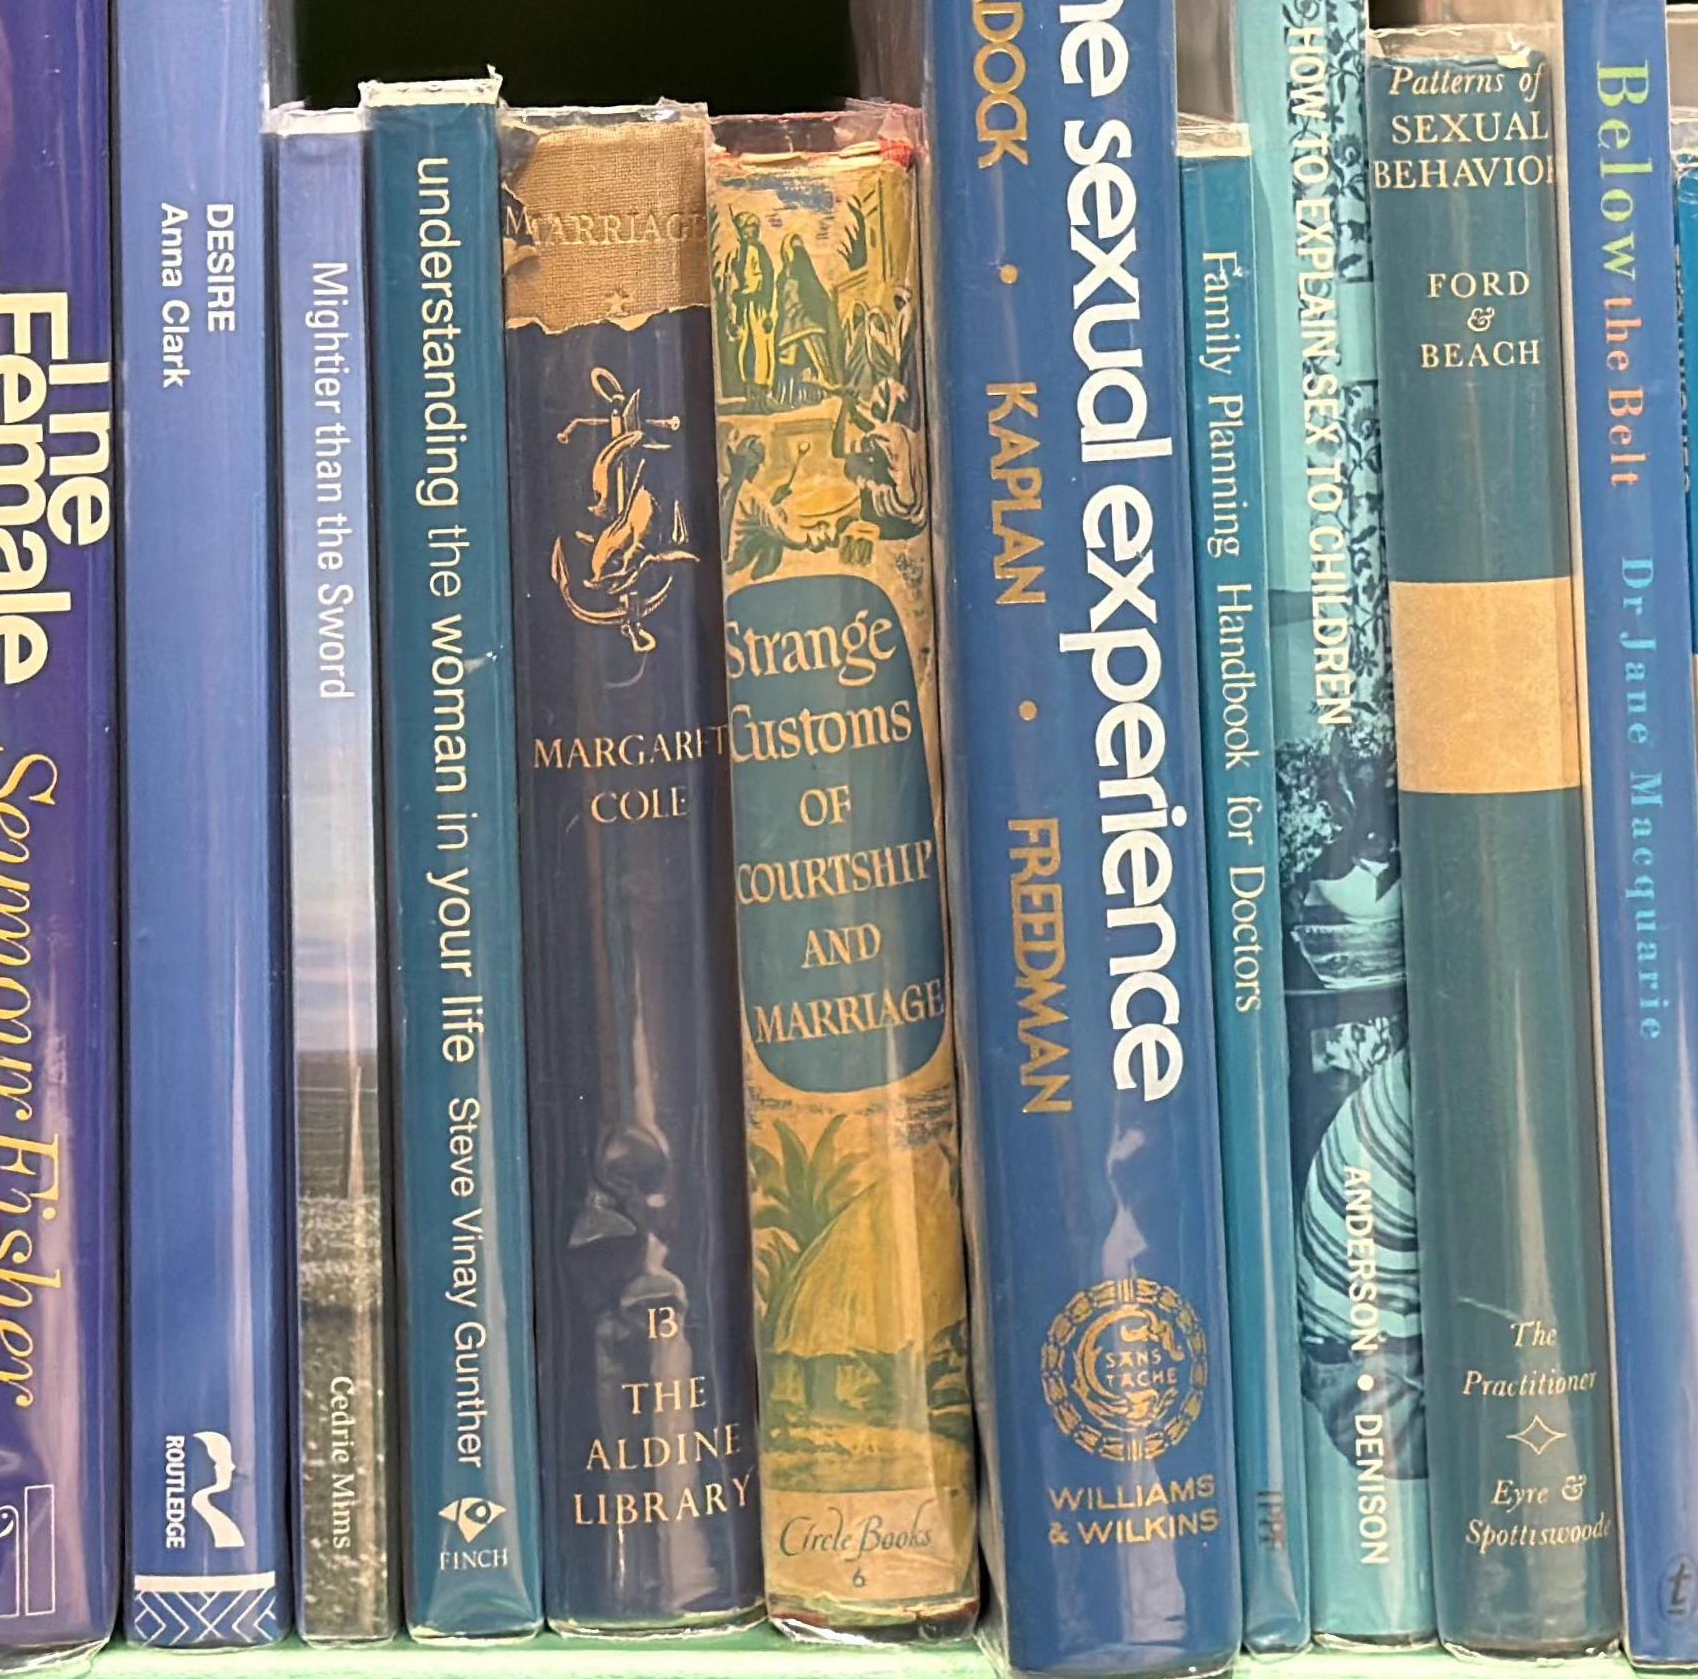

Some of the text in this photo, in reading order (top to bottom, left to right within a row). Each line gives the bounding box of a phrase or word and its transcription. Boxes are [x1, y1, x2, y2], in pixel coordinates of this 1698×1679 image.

[1389, 61, 1546, 101] Patterns of
[1392, 110, 1548, 144] SEXUAL
[206, 204, 235, 333] DESIRE
[1064, 120, 1172, 462] sexual
[1428, 271, 1530, 298] FORD
[161, 203, 191, 388] Anna Clark
[1289, 27, 1353, 726] HOW TO EXPLAIN SEX TO CHILDREN
[1421, 340, 1540, 368] BEACH
[307, 262, 356, 700] Mightier than the Sword
[985, 382, 1045, 605] KAPLAN
[415, 157, 485, 1064] understanding the woman in your life
[1200, 250, 1266, 1013] Family Planning Handbook for Doctors
[726, 612, 901, 687] Strange
[533, 725, 728, 768] MARGARET
[729, 699, 910, 765] Customs
[590, 786, 687, 823] COLE
[1059, 486, 1186, 1101] experience
[738, 838, 933, 904] COURTSHIP
[801, 923, 881, 970] AND
[1007, 817, 1072, 1114] FREEDMAN
[754, 978, 943, 1044] MARRIAGE
[445, 1097, 486, 1469] Steve Vinay Gunther
[1105, 1349, 1161, 1368] SANS
[1511, 1320, 1557, 1348] The
[1106, 1367, 1177, 1387] TACHE
[1341, 1166, 1389, 1565] ANDERSON DENISON
[1462, 1368, 1597, 1398] Practitioner
[622, 1376, 706, 1415] THE
[328, 1375, 356, 1548] Cedric Mims
[585, 1422, 741, 1470] ALDINE
[164, 1434, 186, 1550] ROUTLEDGE
[574, 1473, 755, 1526] LIBRARY
[1049, 1474, 1214, 1510] WILLIAMS
[1492, 1473, 1587, 1507] Eyre &
[780, 1505, 933, 1562] Circle Books
[1049, 1509, 1219, 1544] & WILKINS
[1464, 1516, 1611, 1553] Spottiswoode
[438, 1548, 509, 1571] FINCH
[852, 1567, 864, 1588] 6
